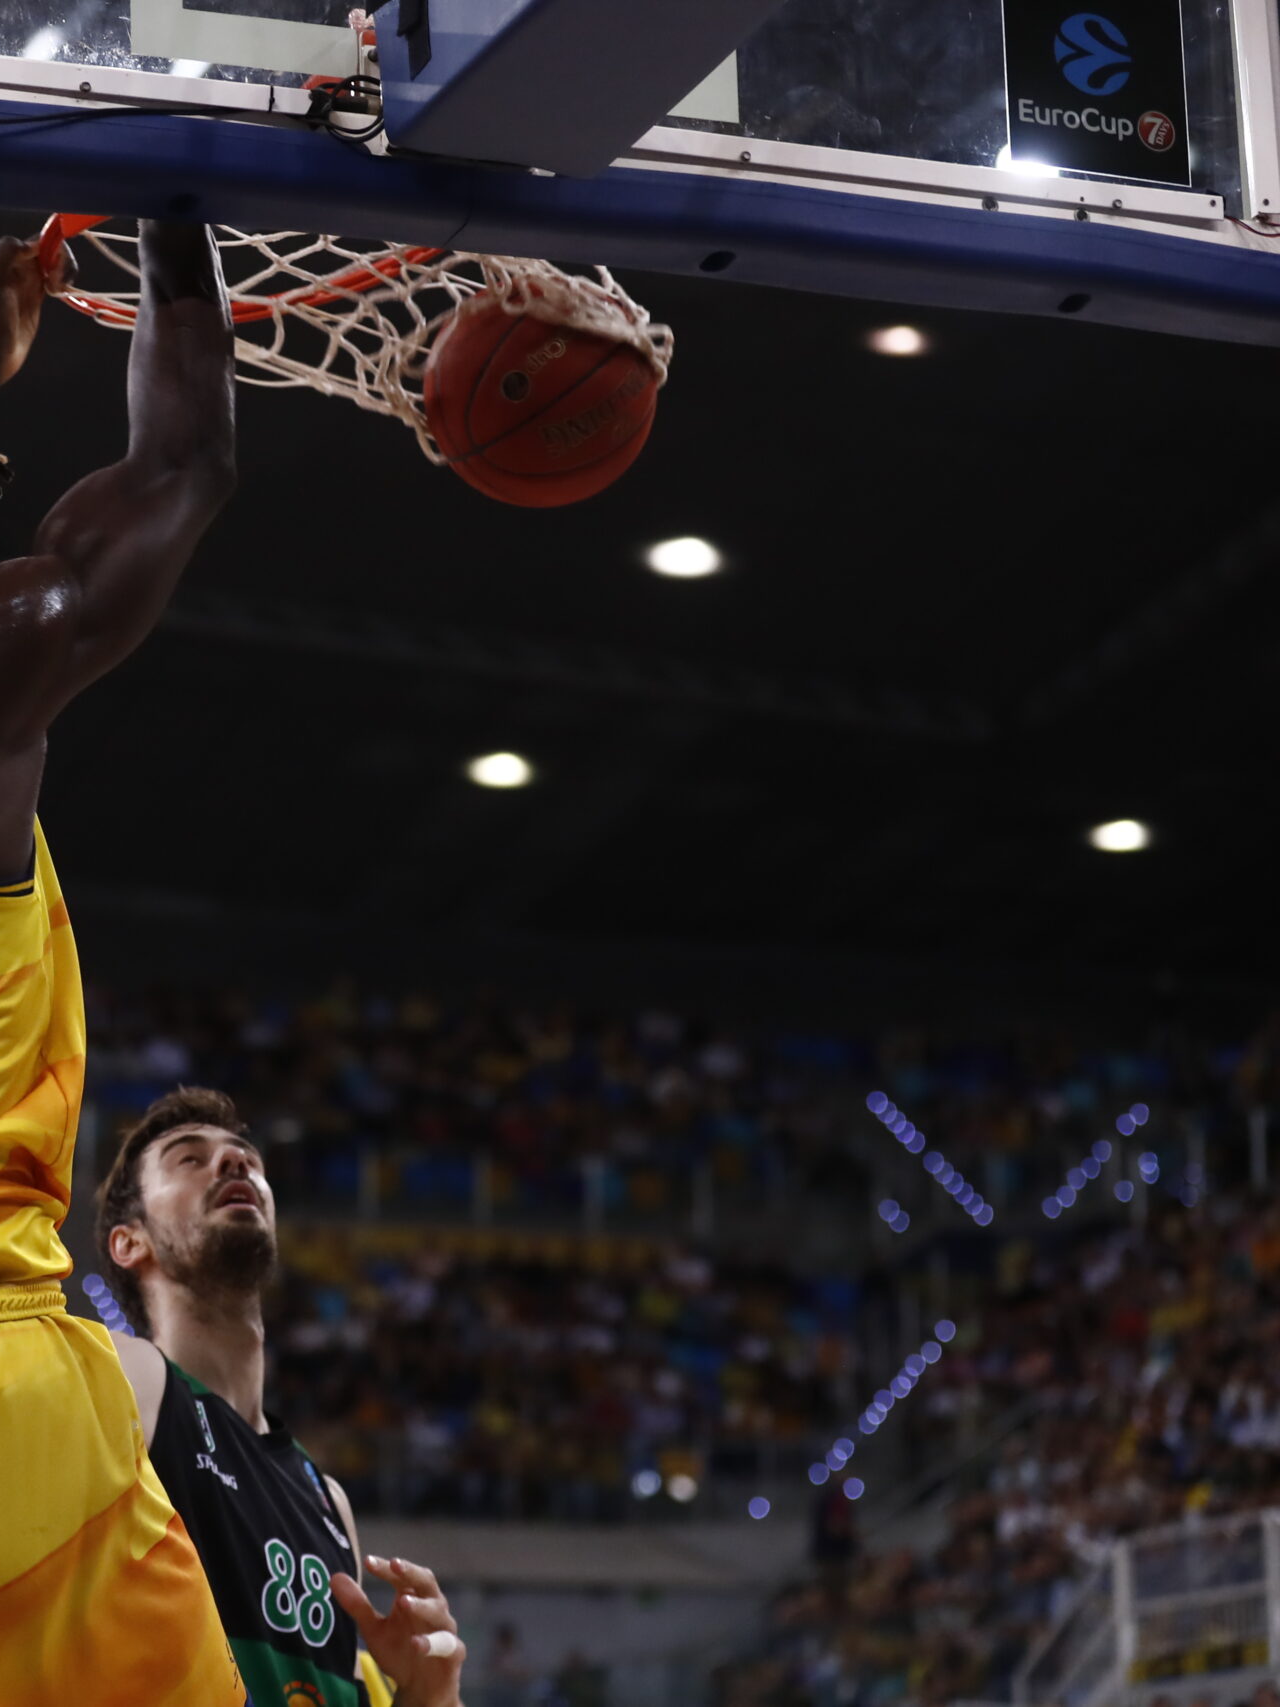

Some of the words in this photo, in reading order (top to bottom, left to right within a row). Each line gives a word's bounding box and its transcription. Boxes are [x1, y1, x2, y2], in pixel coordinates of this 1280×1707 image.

[1018, 98, 1134, 141] EuroCup
[1141, 114, 1164, 145] 7
[1155, 122, 1170, 146] DAYS
[261, 1538, 335, 1648] 88
